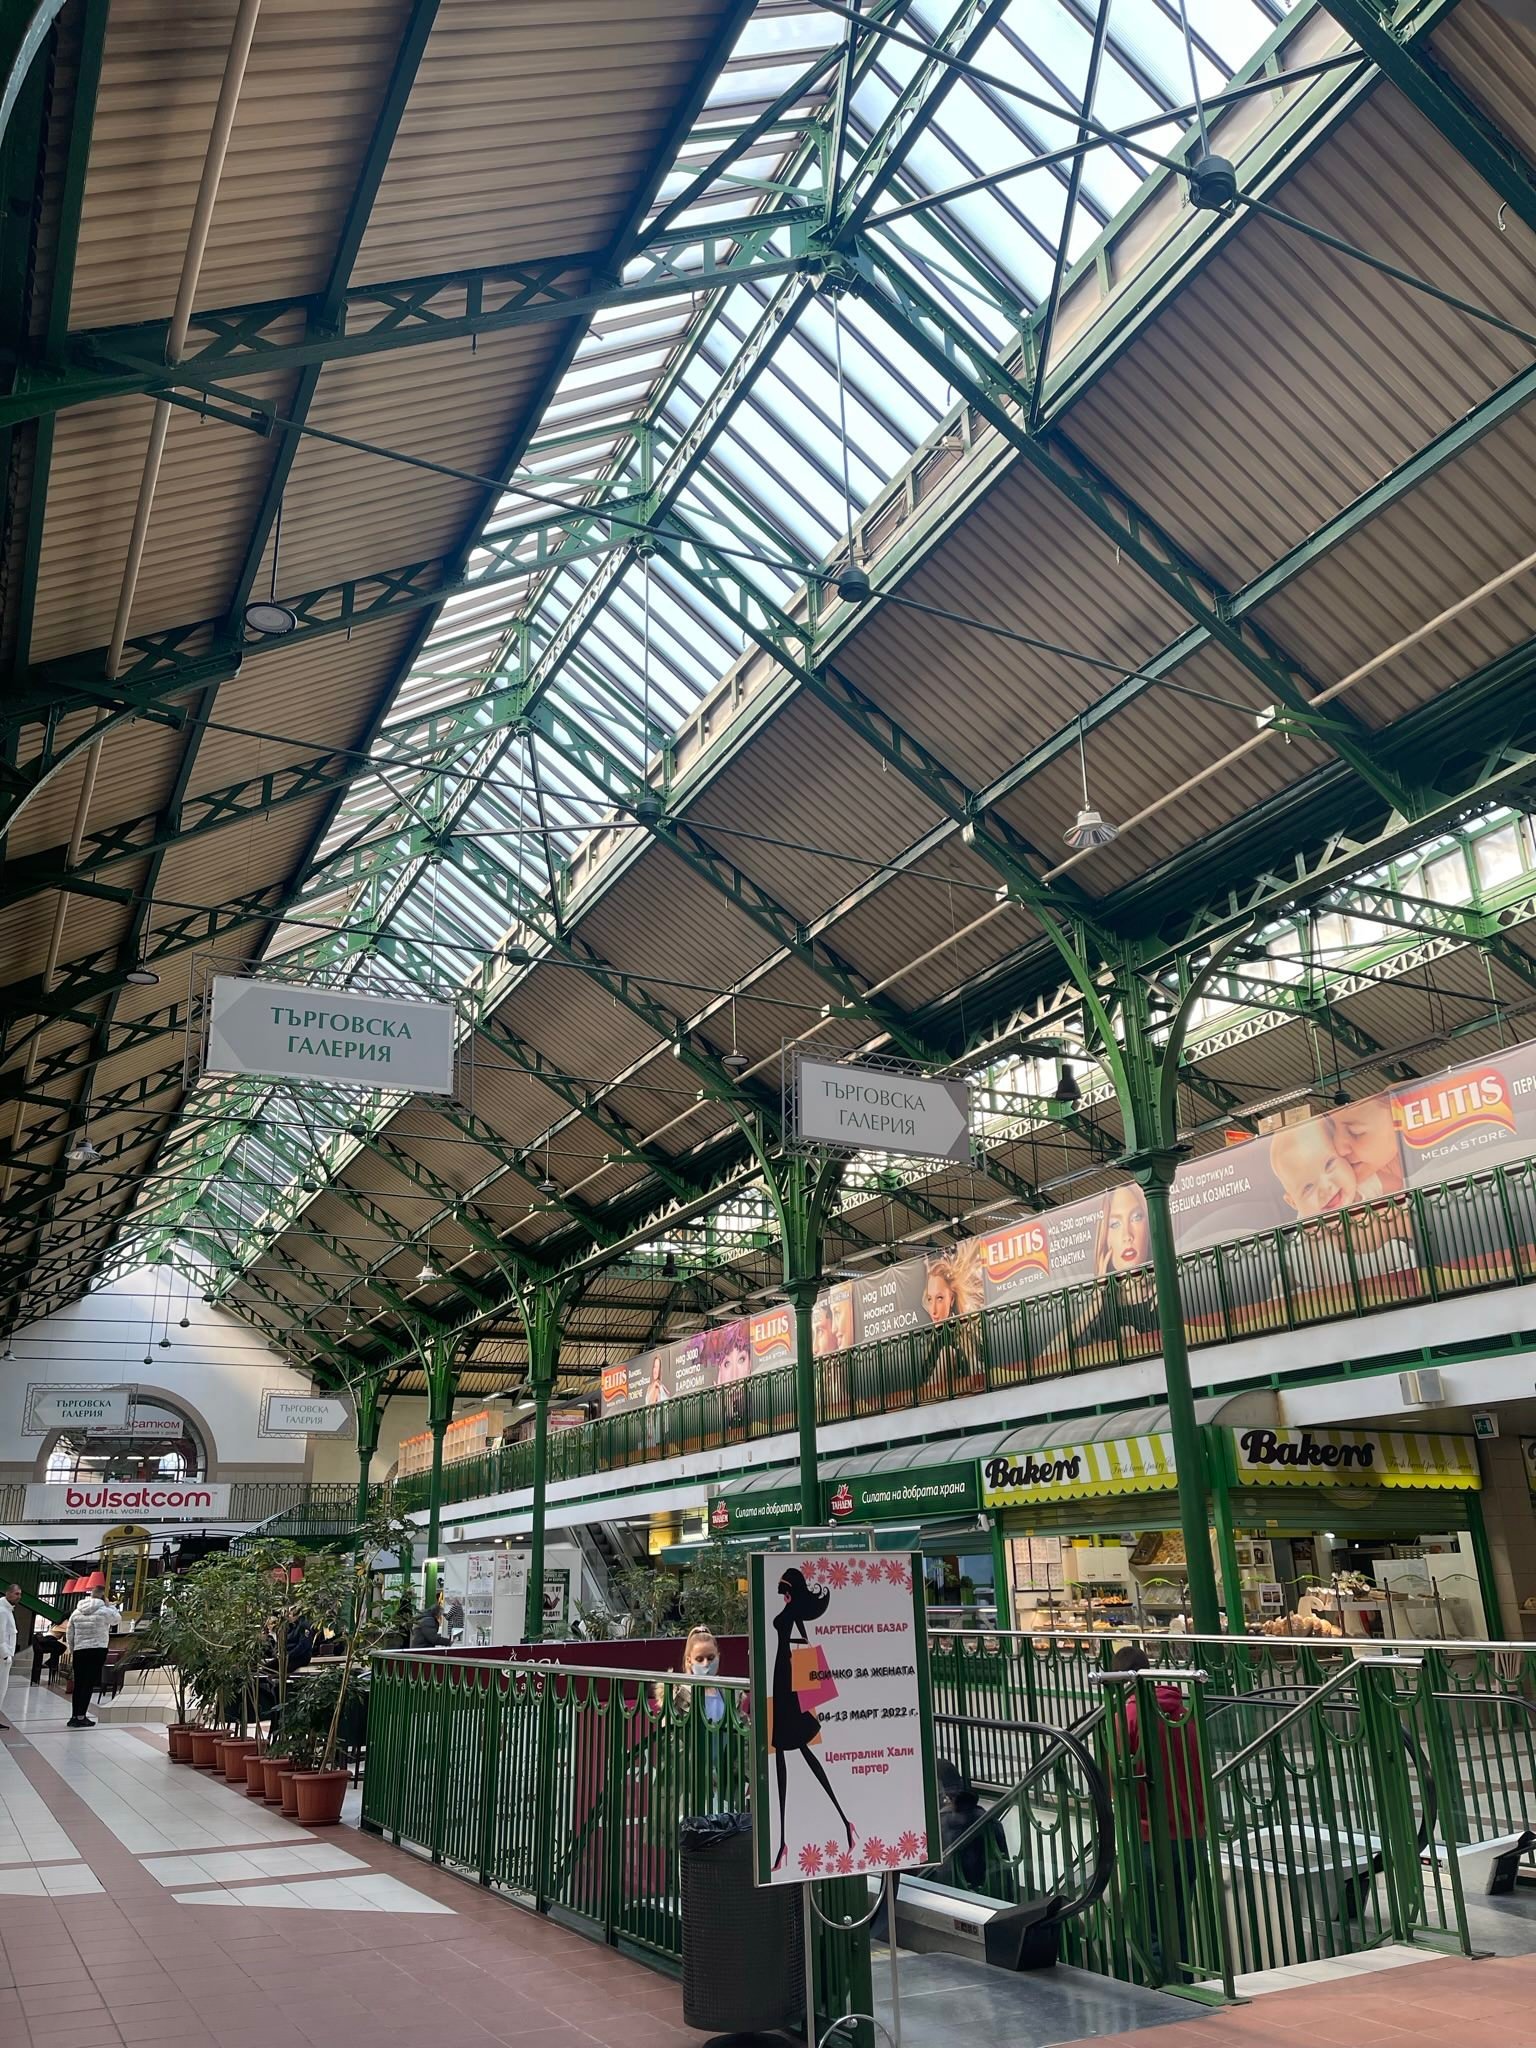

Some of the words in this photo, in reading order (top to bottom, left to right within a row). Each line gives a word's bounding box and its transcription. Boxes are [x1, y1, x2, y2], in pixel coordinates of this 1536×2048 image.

[271, 1006, 412, 1039] ТЪРГОВСКА
[288, 1036, 391, 1062] ГАЛЕРИЯ
[821, 1080, 926, 1112] ТЪРГОВСКА
[1403, 1075, 1503, 1131] ELITIS
[840, 1109, 915, 1136] ГАЛЕРИЯ
[1181, 1175, 1195, 1191] 300
[1196, 1164, 1234, 1187] артикула
[1203, 1177, 1251, 1205] КОЗМЕТИКА
[1060, 1217, 1074, 1232] 2500
[1075, 1210, 1104, 1228] артикула
[988, 1228, 1044, 1266] ELITIS
[1050, 1229, 1092, 1253] ДЕКОРАТИВНА
[1050, 1249, 1086, 1269] КОЗМЕТИКА
[862, 1290, 877, 1304] над
[879, 1281, 897, 1298] 1000
[863, 1302, 895, 1320] нюанса
[755, 1315, 789, 1342] ELITIS
[864, 1322, 880, 1338] БОЯ
[881, 1319, 892, 1333] ЗА
[893, 1311, 919, 1329] КОСА
[604, 1369, 627, 1390] ELITIS
[56, 1399, 112, 1408] ТЪРГОВСКА
[62, 1410, 103, 1418] ГАЛЕРИЯ
[280, 1404, 329, 1414] ТЪРГОВСКА
[286, 1416, 323, 1425] ГАЛЕРИЯ
[1240, 1429, 1376, 1468] Bakers
[985, 1455, 1082, 1489] Bakers
[65, 1487, 211, 1508] bulsatcom
[861, 1490, 891, 1504] Силата
[892, 1489, 901, 1501] на
[902, 1485, 939, 1502] добрата
[940, 1481, 966, 1498] храна
[735, 1507, 758, 1519] Силата
[758, 1506, 766, 1516] на
[766, 1502, 793, 1517] добрата
[831, 1499, 853, 1510] ТАНДЕМ
[815, 1623, 874, 1636] МАРТЕНСКИ
[877, 1622, 909, 1633] БАЗАР
[809, 1668, 853, 1681] ВСИЧКО
[854, 1667, 869, 1679] ЗА
[870, 1665, 916, 1678] ЖЕНАТА
[817, 1711, 848, 1722] 04-13
[849, 1708, 879, 1720] МАРТ
[880, 1707, 907, 1719] 2022
[825, 1748, 885, 1764] Централни
[886, 1746, 915, 1758] Хали
[851, 1763, 889, 1776] партер
